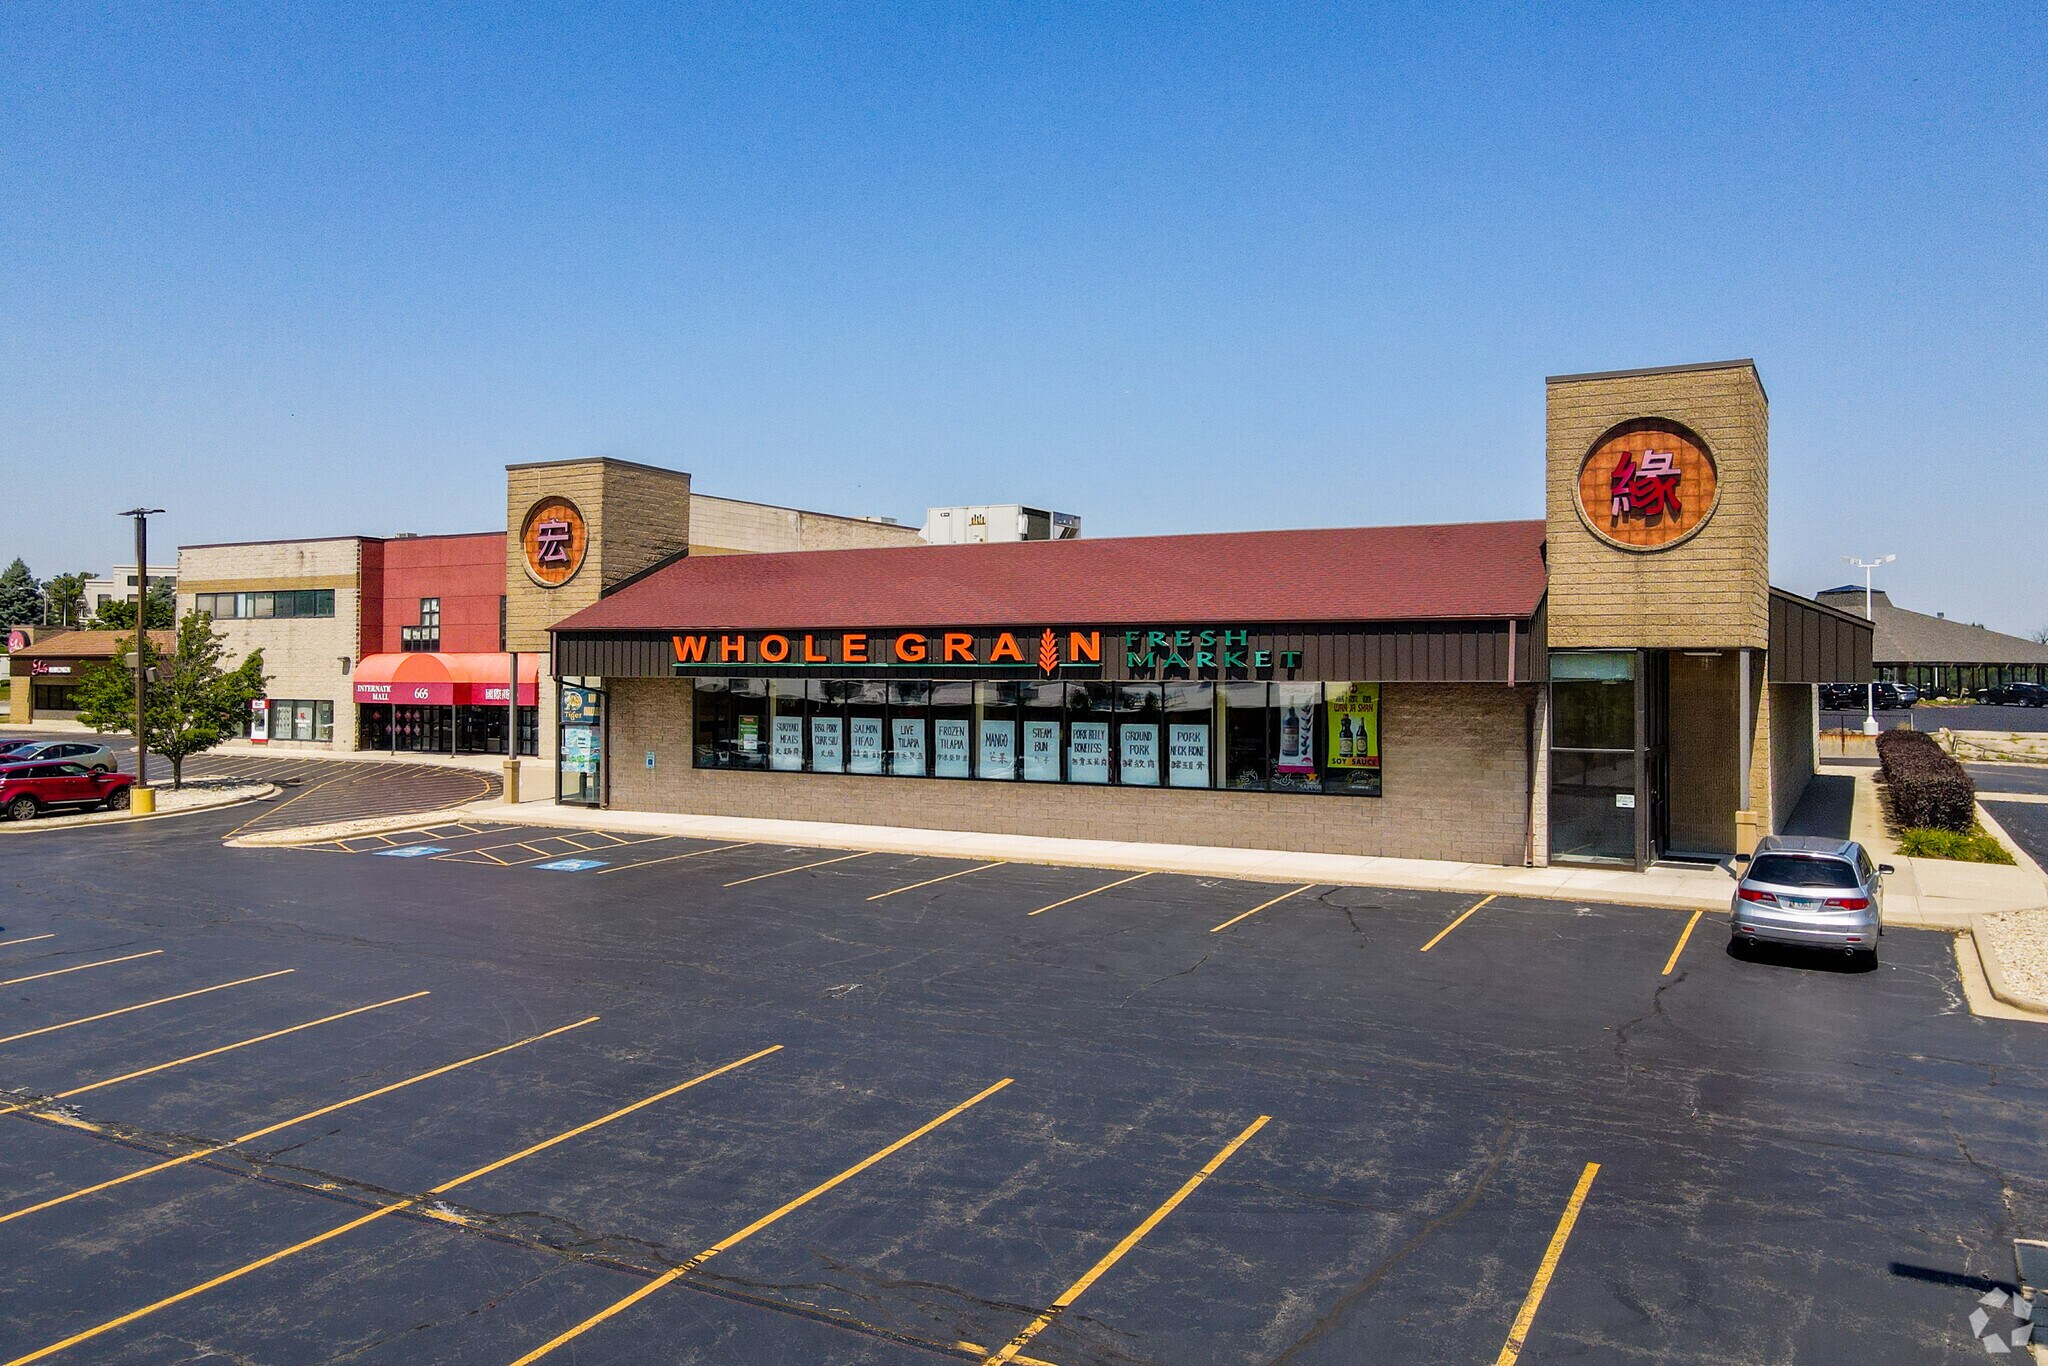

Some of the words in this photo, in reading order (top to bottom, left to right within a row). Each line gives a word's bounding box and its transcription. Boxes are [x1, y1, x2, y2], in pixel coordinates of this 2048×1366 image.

[1612, 449, 1682, 516] 緣
[537, 519, 571, 562] 宏
[1125, 629, 1249, 647] FRESH
[672, 634, 868, 662] WHOLE
[1126, 650, 1303, 668] MARKET
[372, 693, 389, 701] MALL
[414, 687, 429, 699] 665
[1334, 704, 1348, 712] WAN
[1358, 703, 1374, 712] SHAN
[564, 711, 582, 720] Tiger
[826, 724, 838, 733] PORK
[853, 724, 878, 734] SALMON
[900, 725, 914, 735] LIVE
[938, 726, 965, 736] FROZEN
[1032, 728, 1052, 738] STEAM
[780, 735, 799, 744] MEATS
[985, 732, 1009, 748] MANGO
[1072, 729, 1087, 740] PORK
[1088, 729, 1105, 740] BELLY
[1125, 731, 1153, 742] GROUND
[1177, 731, 1201, 742] PORK
[828, 735, 839, 746] SIU
[855, 736, 875, 747] HEAD
[898, 737, 920, 748] TILAPIA
[940, 738, 965, 749] TILAPIA
[1034, 741, 1048, 752] BUN
[1074, 742, 1102, 754] BONELESS
[1129, 744, 1150, 755] PORK
[1170, 745, 1187, 756] NECK
[1188, 745, 1204, 757] BONE
[1332, 757, 1347, 765] SOY
[1351, 758, 1377, 766] SAUCE
